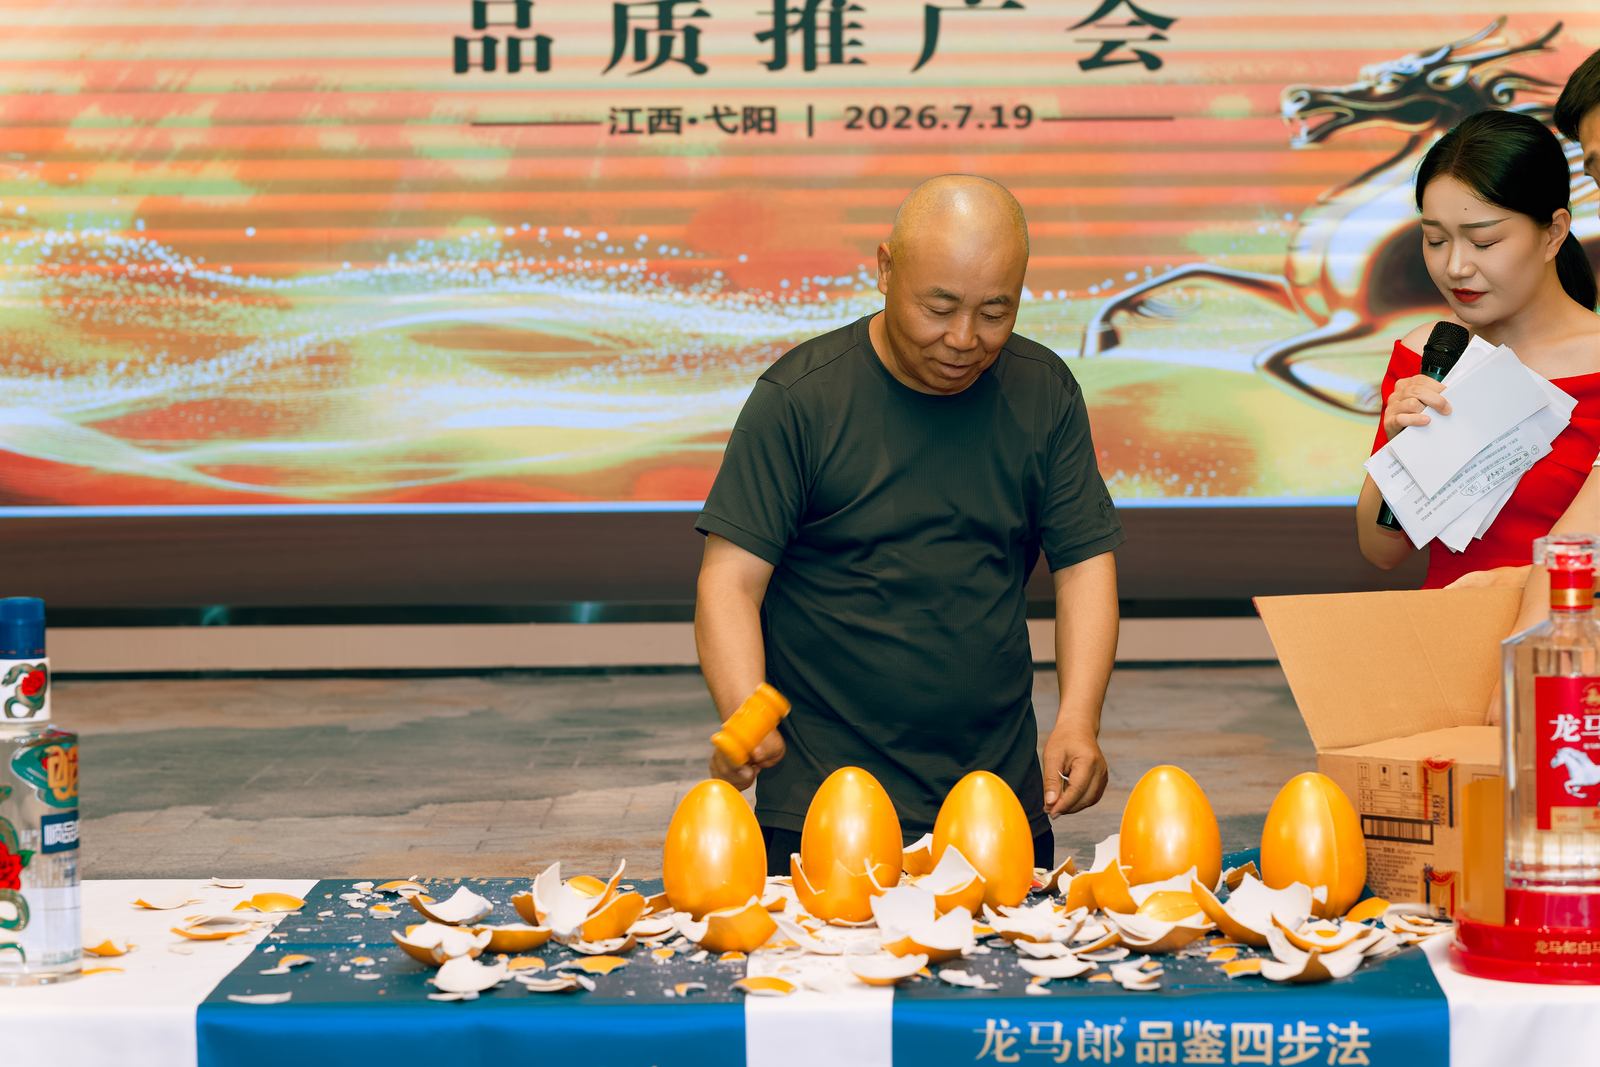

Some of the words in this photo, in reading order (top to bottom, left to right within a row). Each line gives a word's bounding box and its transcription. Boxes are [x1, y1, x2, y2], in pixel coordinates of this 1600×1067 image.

[453, 0, 1178, 77] 品质推广会
[608, 104, 777, 136] 江西·弋阳
[843, 104, 1034, 130] 2026.7.19
